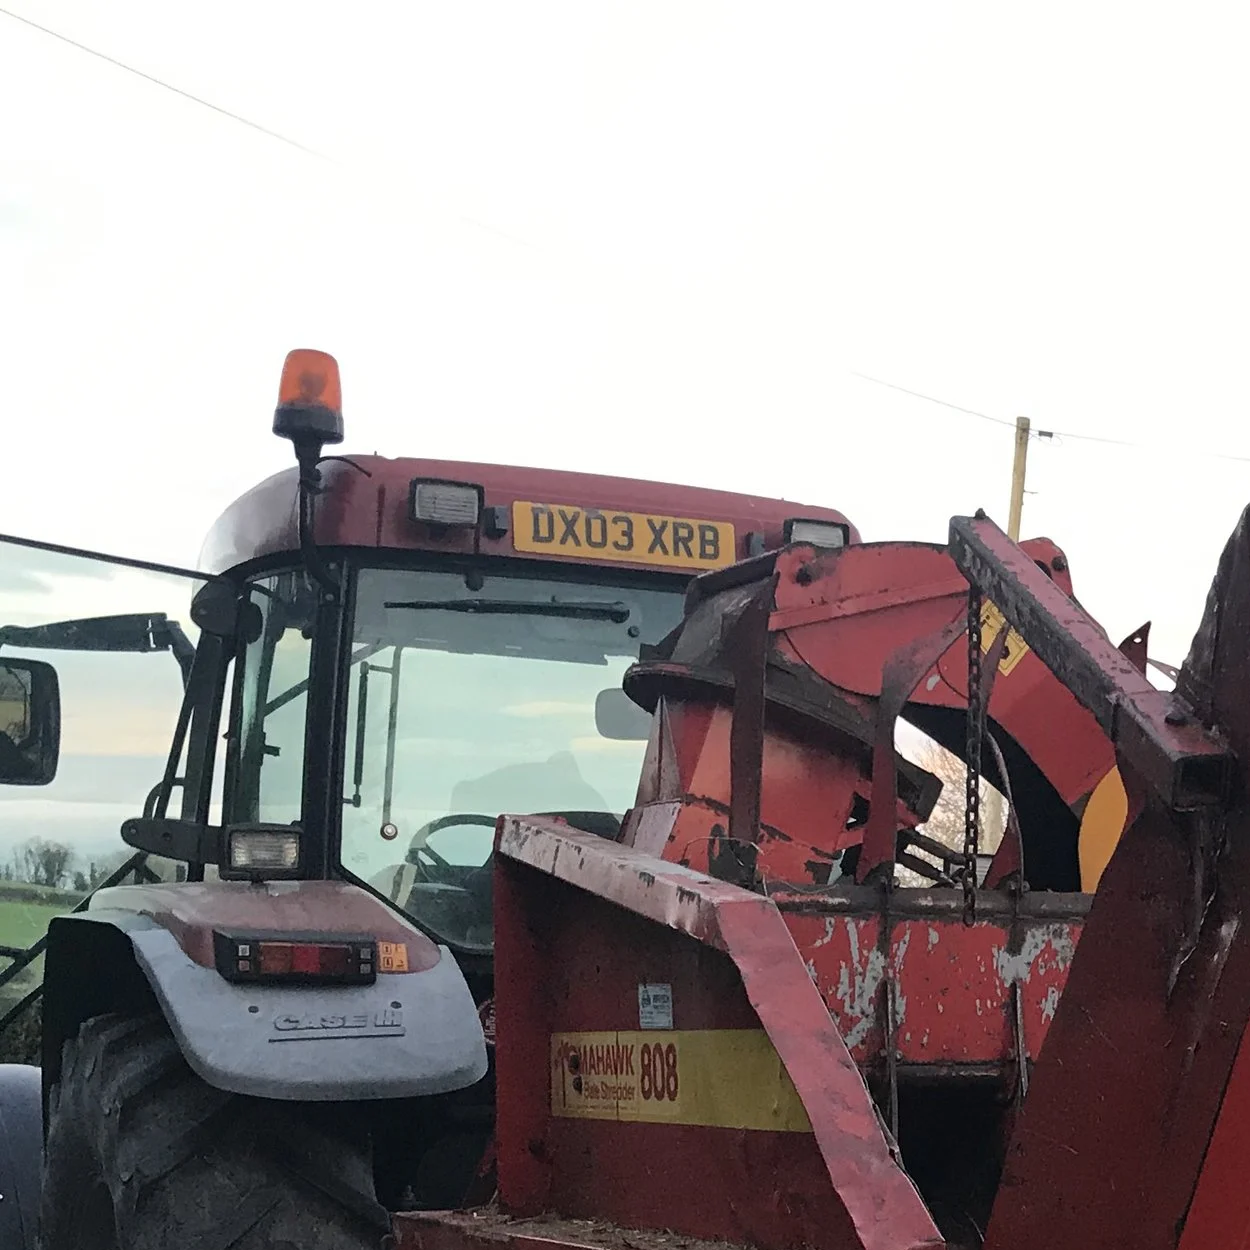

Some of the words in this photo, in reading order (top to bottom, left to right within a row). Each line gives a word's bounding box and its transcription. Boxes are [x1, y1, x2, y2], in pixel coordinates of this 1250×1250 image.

[531, 507, 634, 550] DX03
[647, 518, 720, 560] XRB
[273, 1013, 368, 1031] CASE
[601, 1080, 636, 1101] Shredder
[641, 1042, 679, 1102] 808
